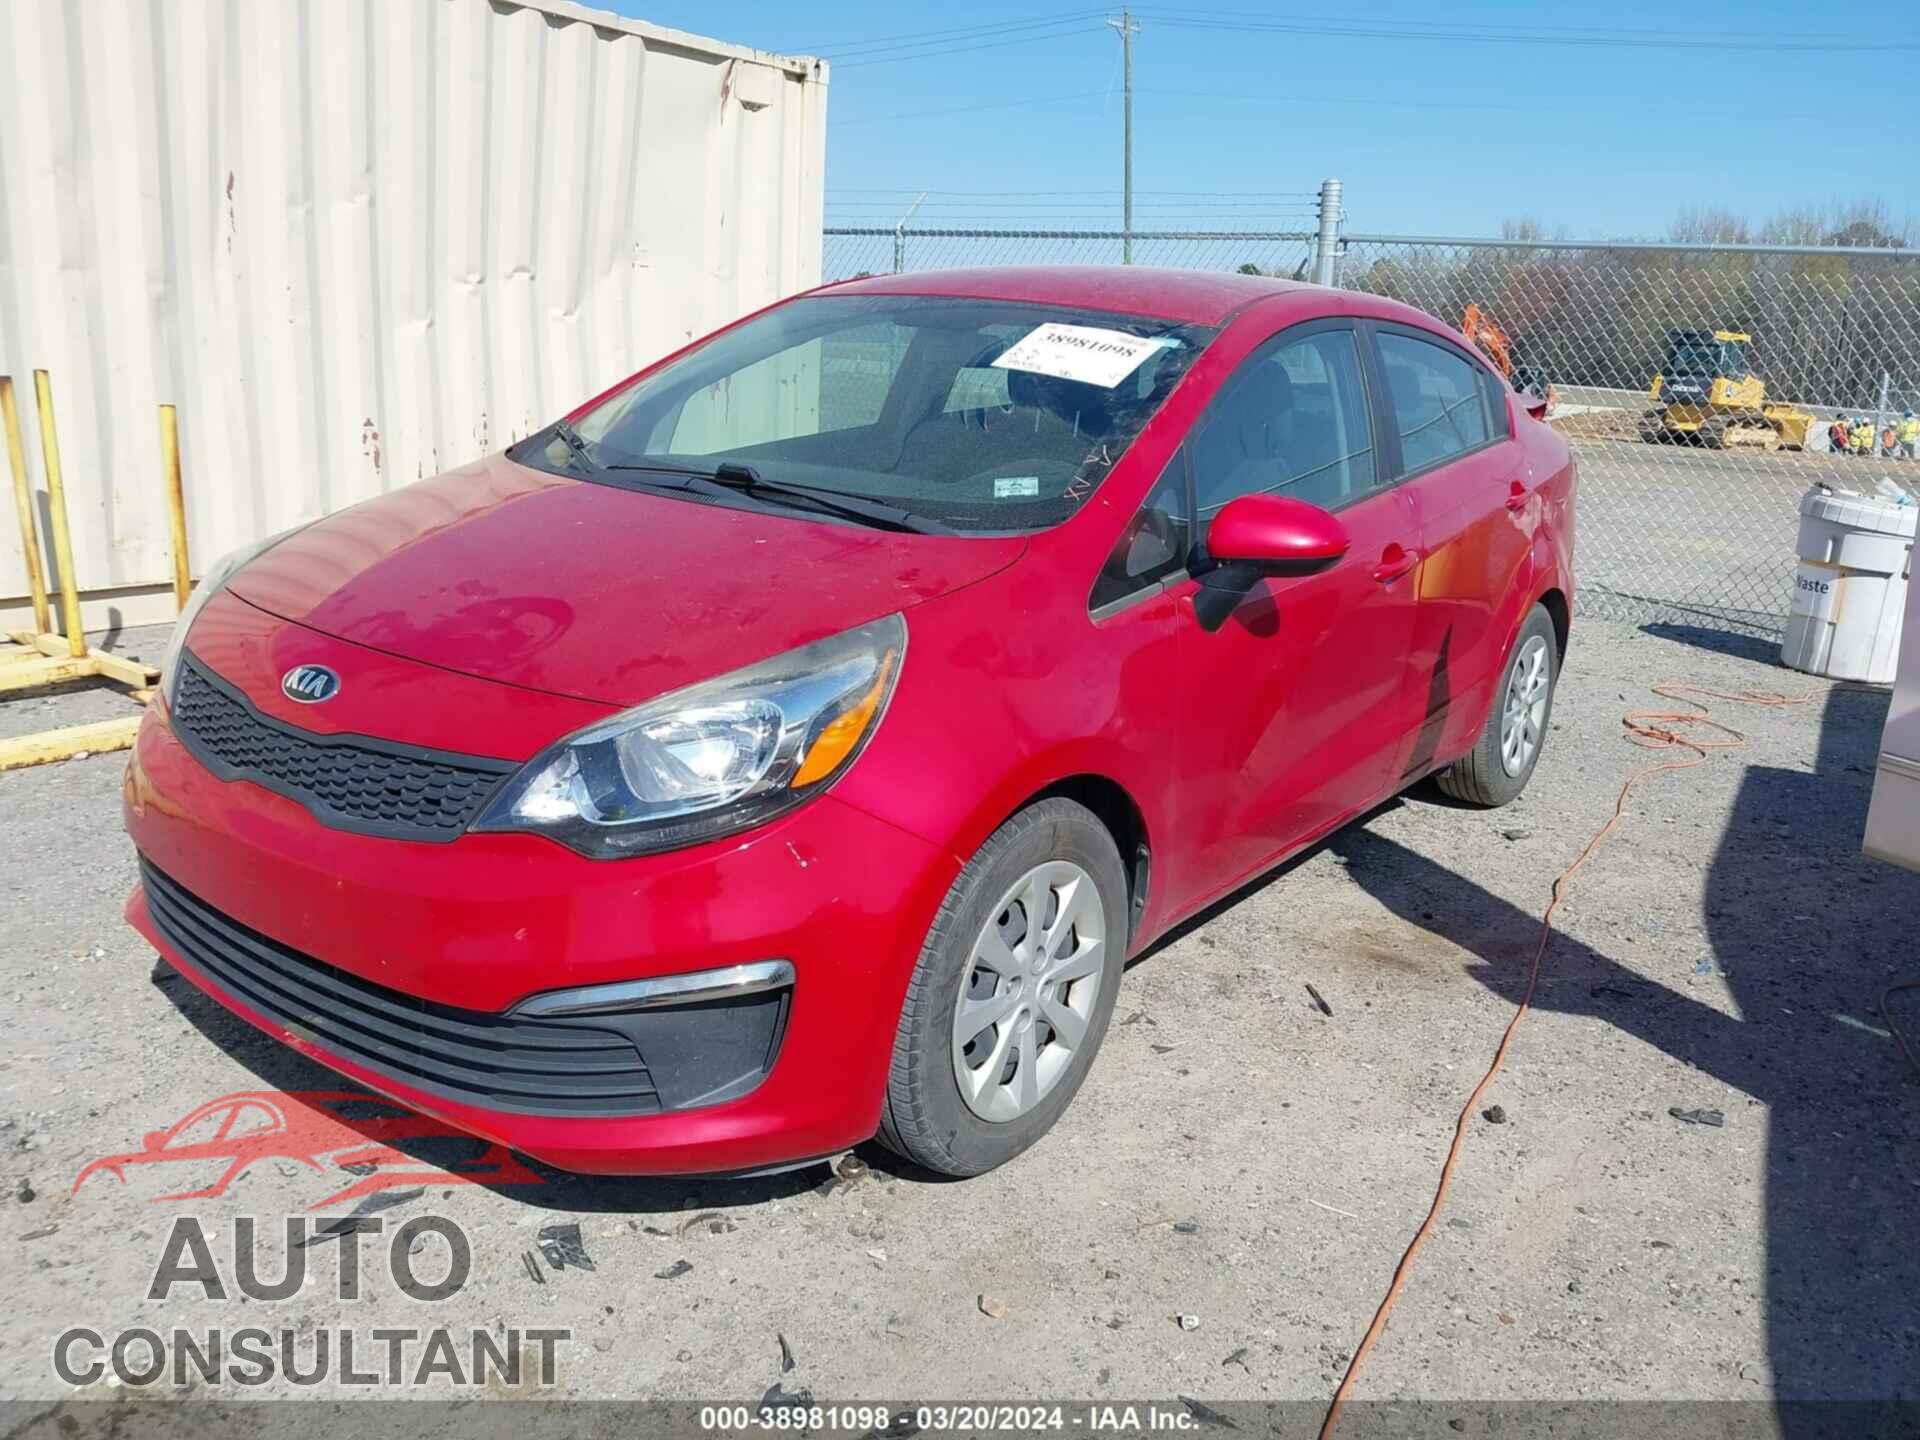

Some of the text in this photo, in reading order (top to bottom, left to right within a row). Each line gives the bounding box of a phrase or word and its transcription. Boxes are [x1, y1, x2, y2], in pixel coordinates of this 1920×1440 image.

[1046, 333, 1136, 357] 38981098
[1796, 574, 1829, 594] aste
[285, 667, 328, 697] KIA
